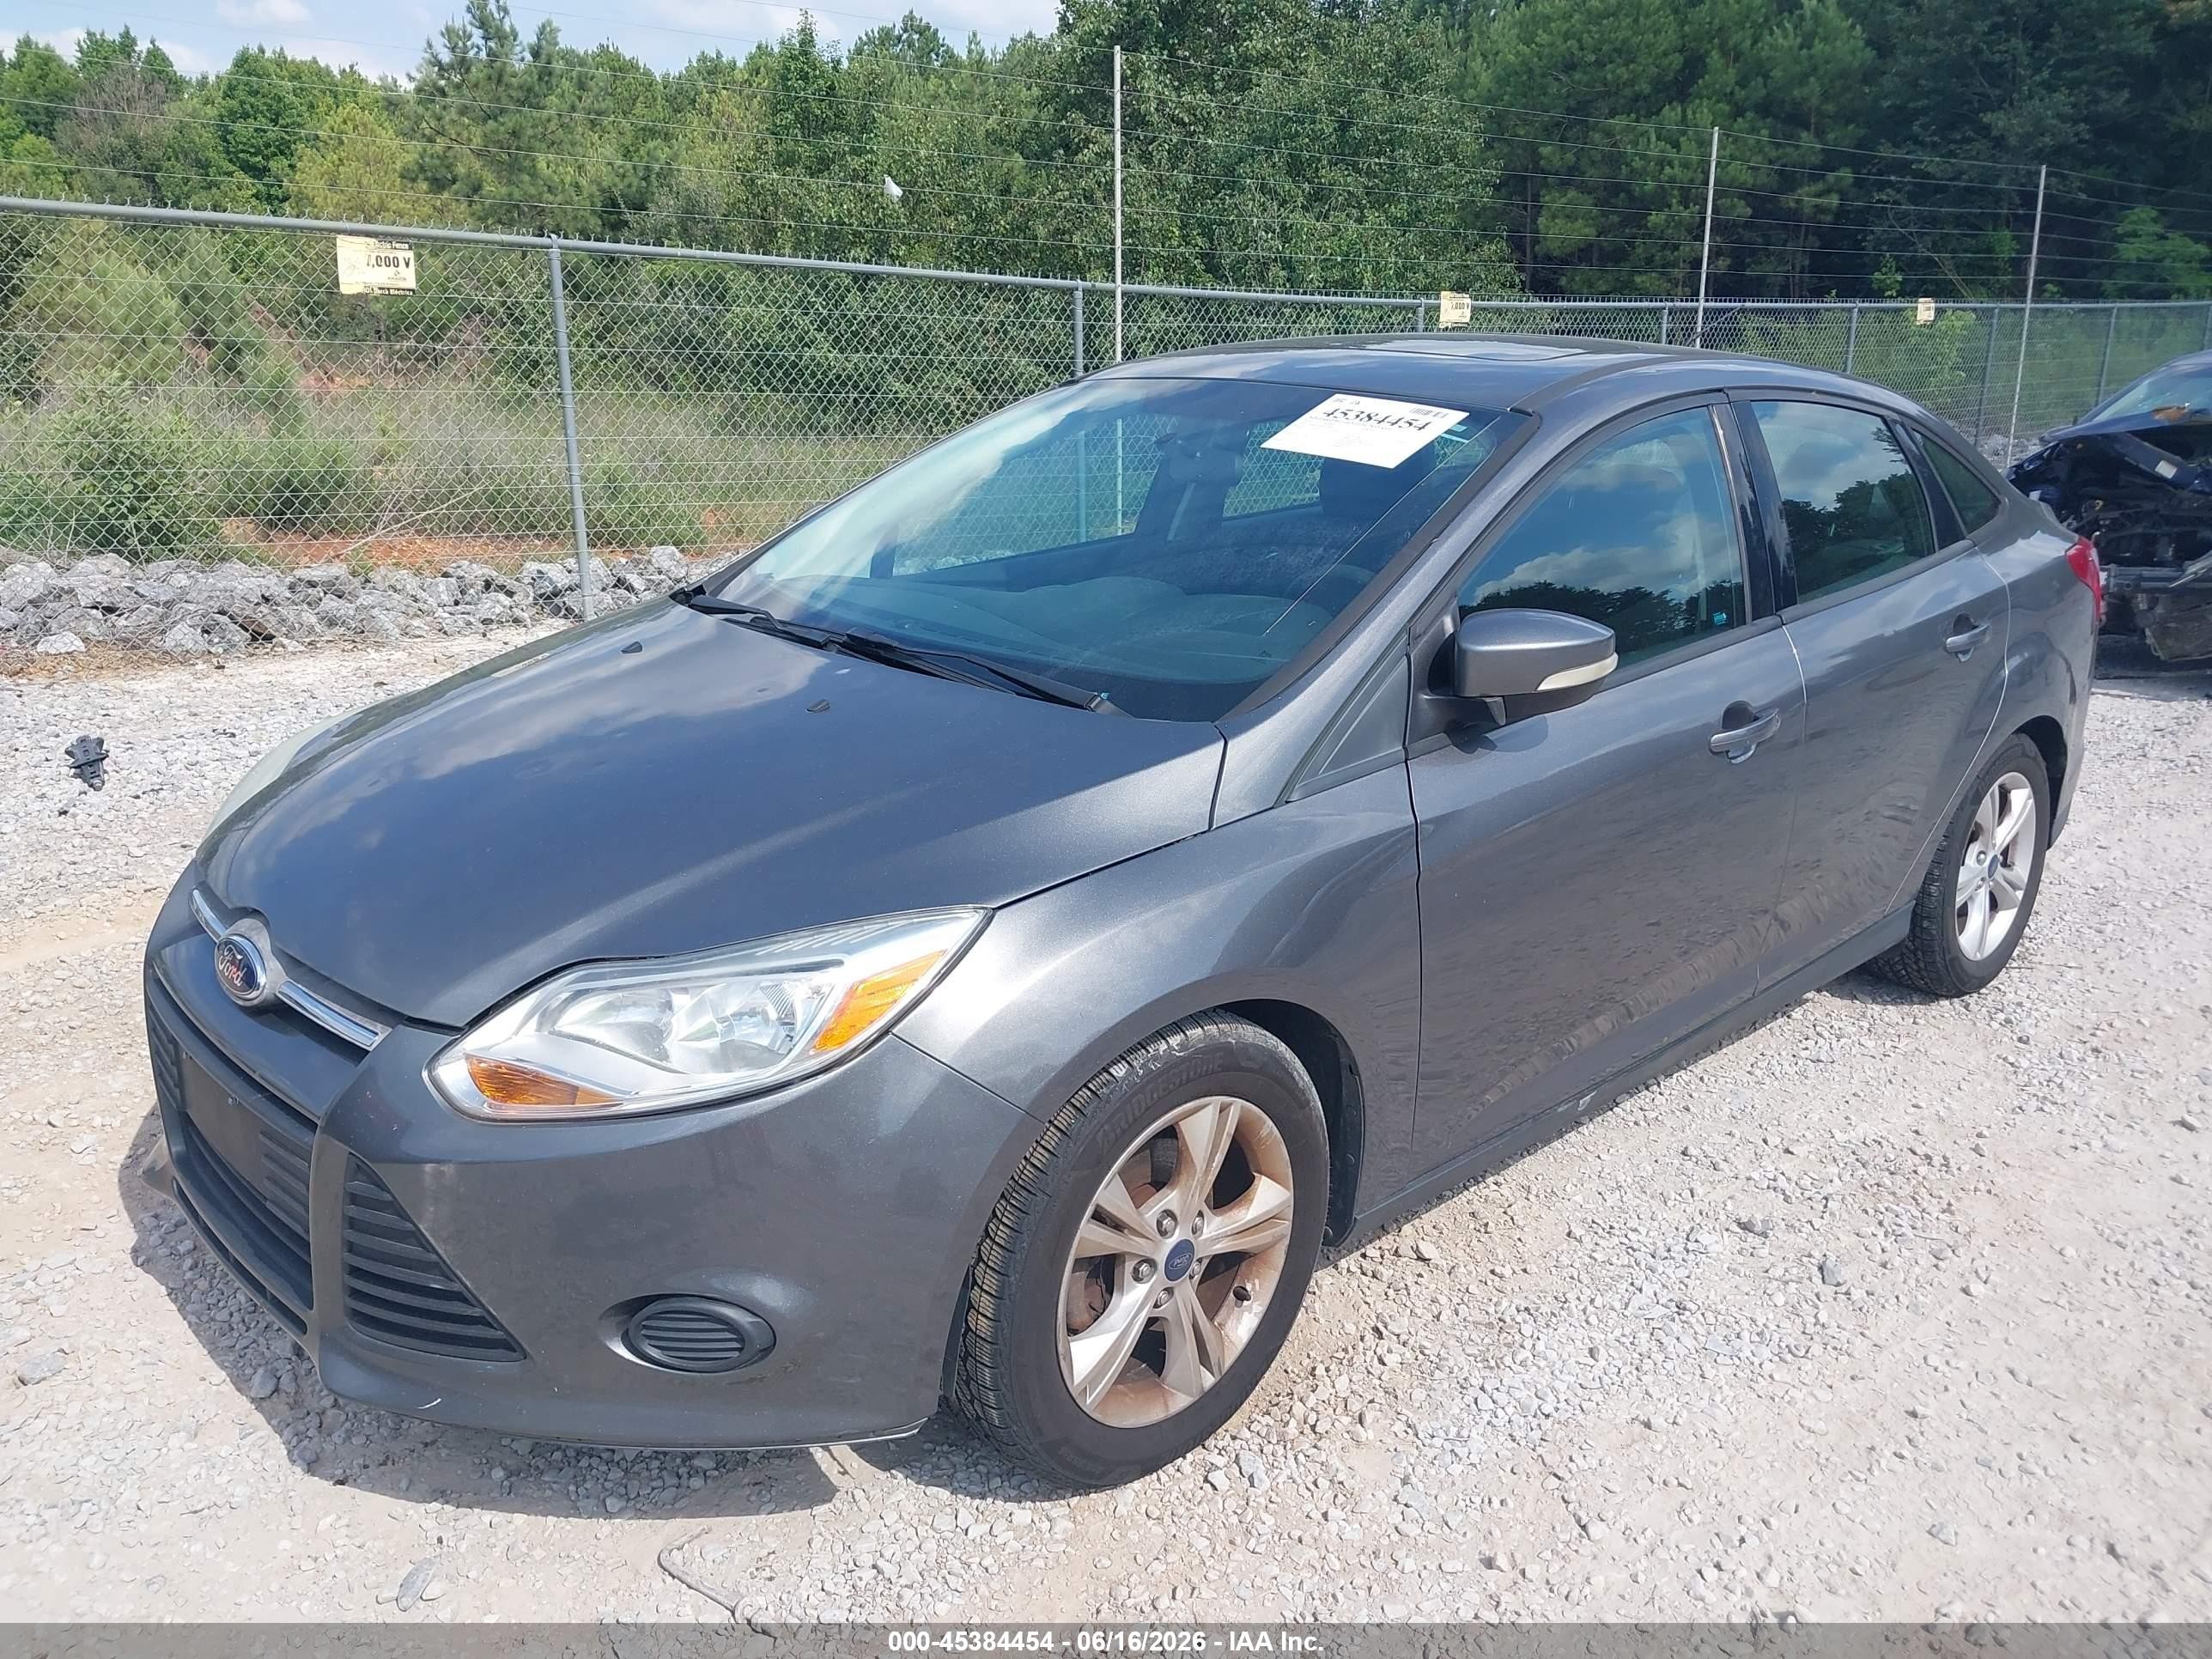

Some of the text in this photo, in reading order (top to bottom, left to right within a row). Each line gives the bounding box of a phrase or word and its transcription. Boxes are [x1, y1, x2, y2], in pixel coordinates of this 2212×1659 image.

[403, 257, 410, 268] V
[1322, 408, 1431, 431] 45384454
[218, 945, 247, 987] Ford
